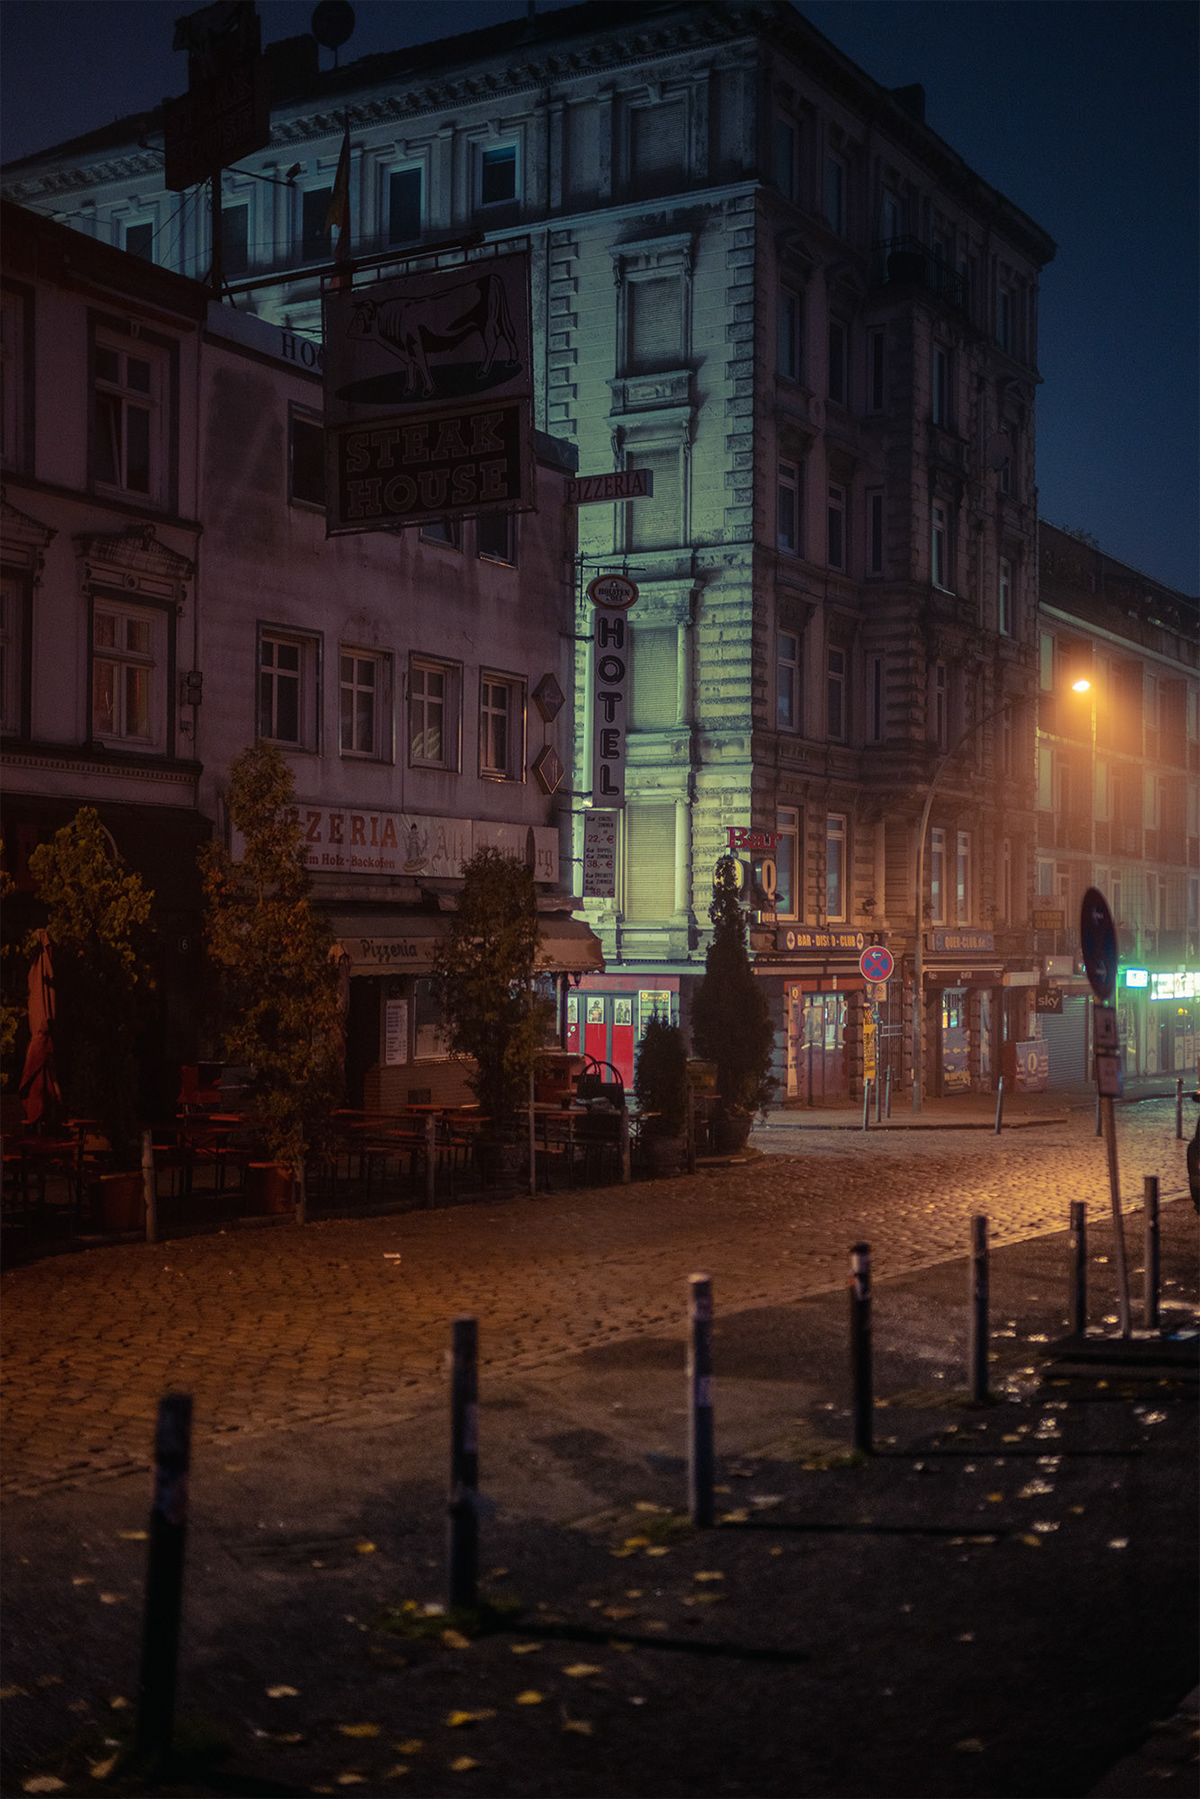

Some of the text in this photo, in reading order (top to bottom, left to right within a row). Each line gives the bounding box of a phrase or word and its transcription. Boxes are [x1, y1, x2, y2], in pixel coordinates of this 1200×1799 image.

[281, 331, 324, 370] HO
[346, 411, 505, 473] STEAK
[347, 458, 508, 519] HOUSE
[567, 471, 644, 503] PIZZERIA
[597, 616, 626, 796] HOTEL
[726, 826, 783, 849] Bar
[351, 855, 396, 869] Backofen
[762, 859, 777, 900] Q
[182, 938, 188, 950] 6
[360, 938, 418, 962] Pizzeria
[1038, 994, 1060, 1008] sky
